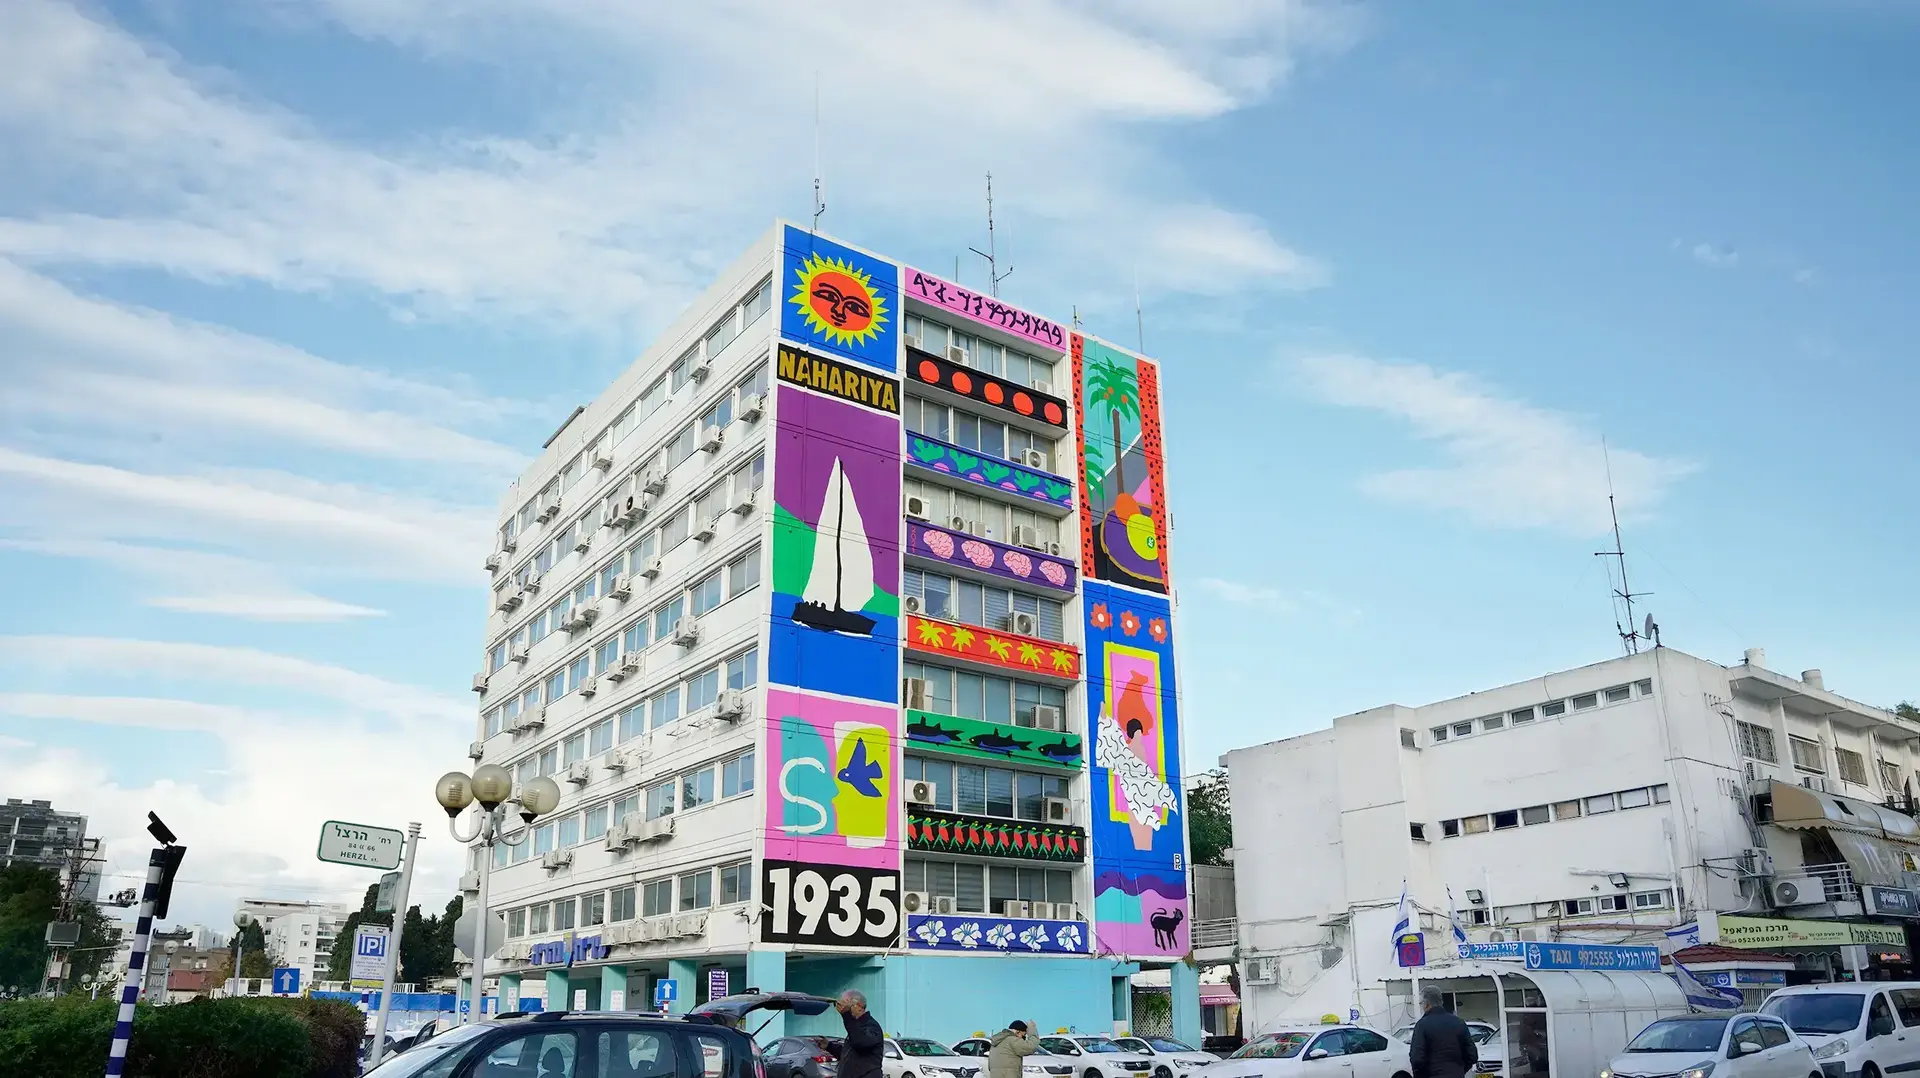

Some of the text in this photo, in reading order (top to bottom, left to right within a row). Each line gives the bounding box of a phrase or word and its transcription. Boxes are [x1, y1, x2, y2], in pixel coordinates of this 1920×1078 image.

[778, 349, 897, 412] NAHARIYA
[336, 825, 368, 841] הרצל
[340, 851, 368, 861] HERZL
[769, 867, 898, 938] 1935
[1723, 924, 1789, 935] מרכז הפלאפל
[1474, 943, 1519, 953] קווי הגליל
[1550, 949, 1657, 968] קווי הגליל 9925555 TAXI
